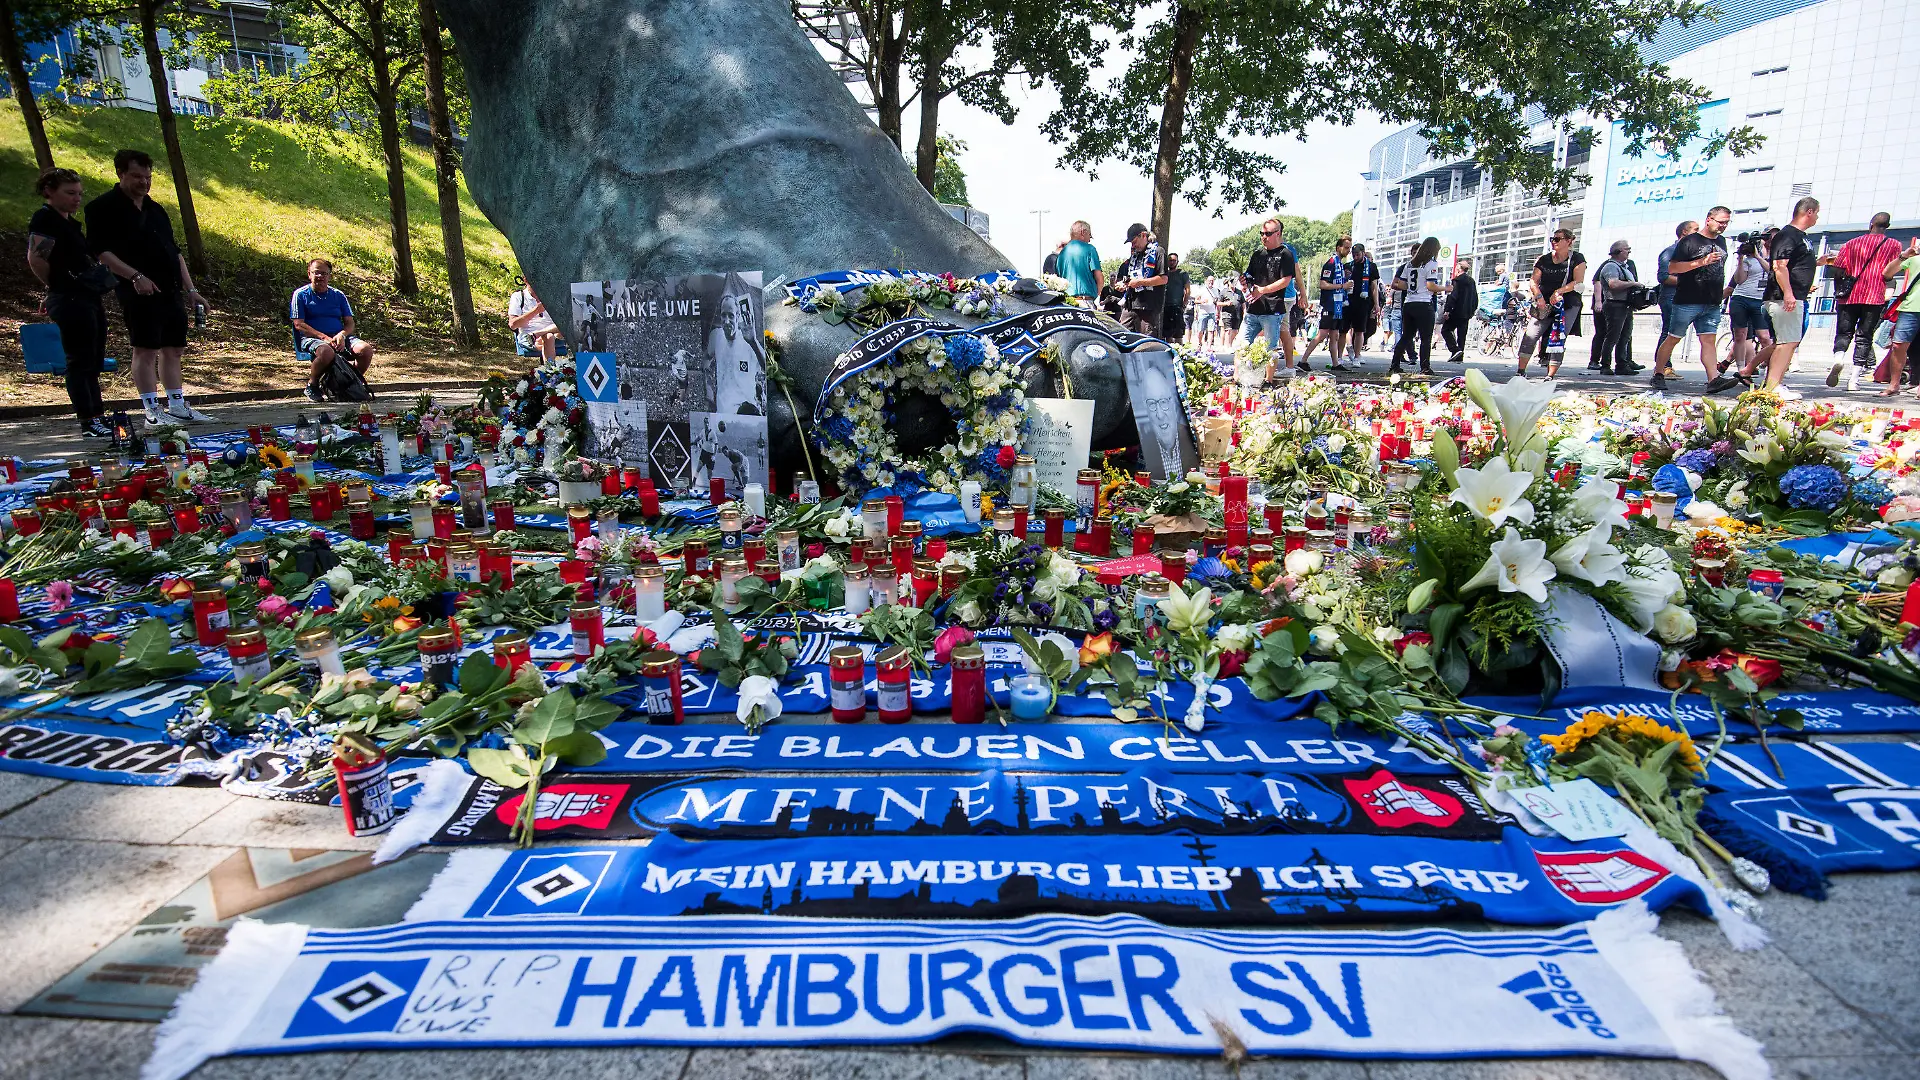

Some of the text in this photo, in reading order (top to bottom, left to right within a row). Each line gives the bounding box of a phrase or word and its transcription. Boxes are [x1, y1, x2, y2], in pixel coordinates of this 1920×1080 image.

[1617, 157, 1708, 186] BARCLAYS
[1634, 185, 1684, 204] Arena
[1409, 269, 1418, 291] 3
[606, 299, 700, 317] DANKE UWE
[1031, 311, 1074, 333] Fans
[625, 734, 1392, 765] DIE BLAUEN CELLER
[446, 778, 504, 836] AMBURG
[664, 776, 1318, 823] MEINE PERLE
[641, 860, 1530, 895] MEIN HAMBURG LIEB' ICH SEHR
[430, 954, 561, 988] R.I.P.
[411, 994, 490, 1015] UNS
[555, 944, 1373, 1039] HAMBURGER SV
[1537, 960, 1618, 1040] adidas
[396, 1015, 493, 1035] UWE
